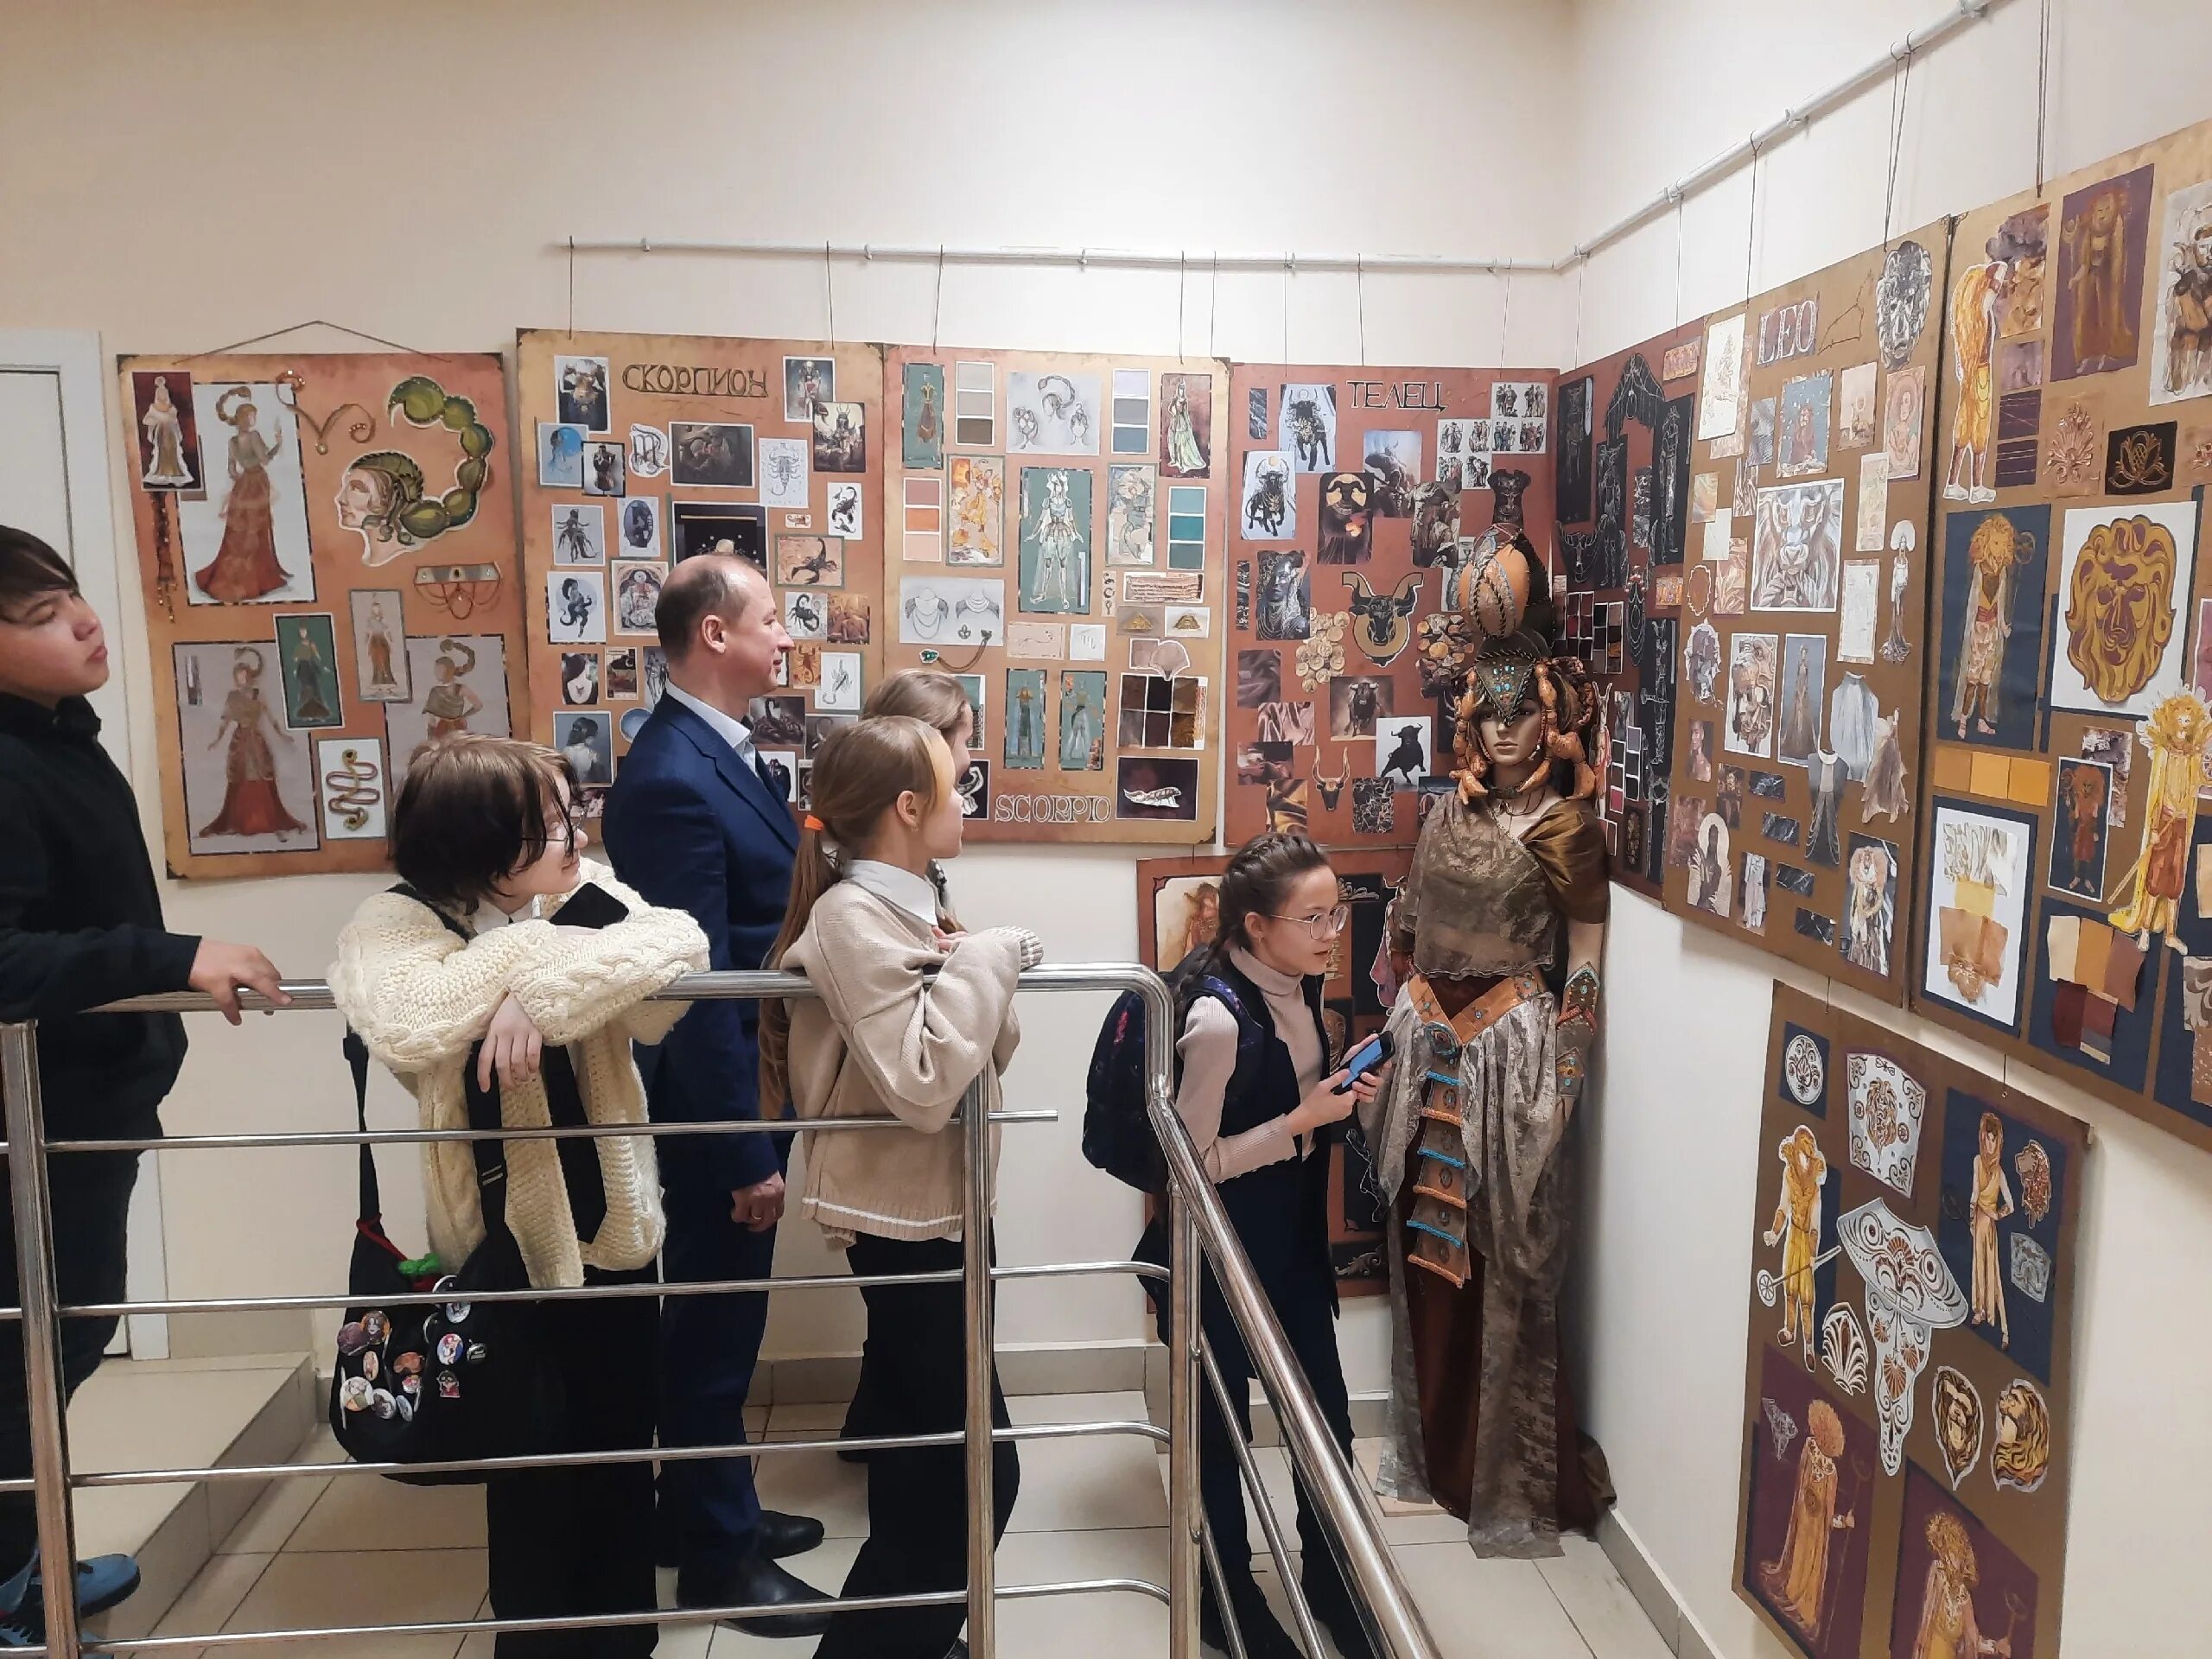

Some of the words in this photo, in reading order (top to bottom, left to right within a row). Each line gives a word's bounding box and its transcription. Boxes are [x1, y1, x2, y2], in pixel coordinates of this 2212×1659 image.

[1757, 300, 1817, 365] LEO
[622, 364, 769, 397] СКОРПИОН
[1346, 380, 1448, 411] ТЕЛЕЦ
[994, 794, 1112, 823] SCORPIO
